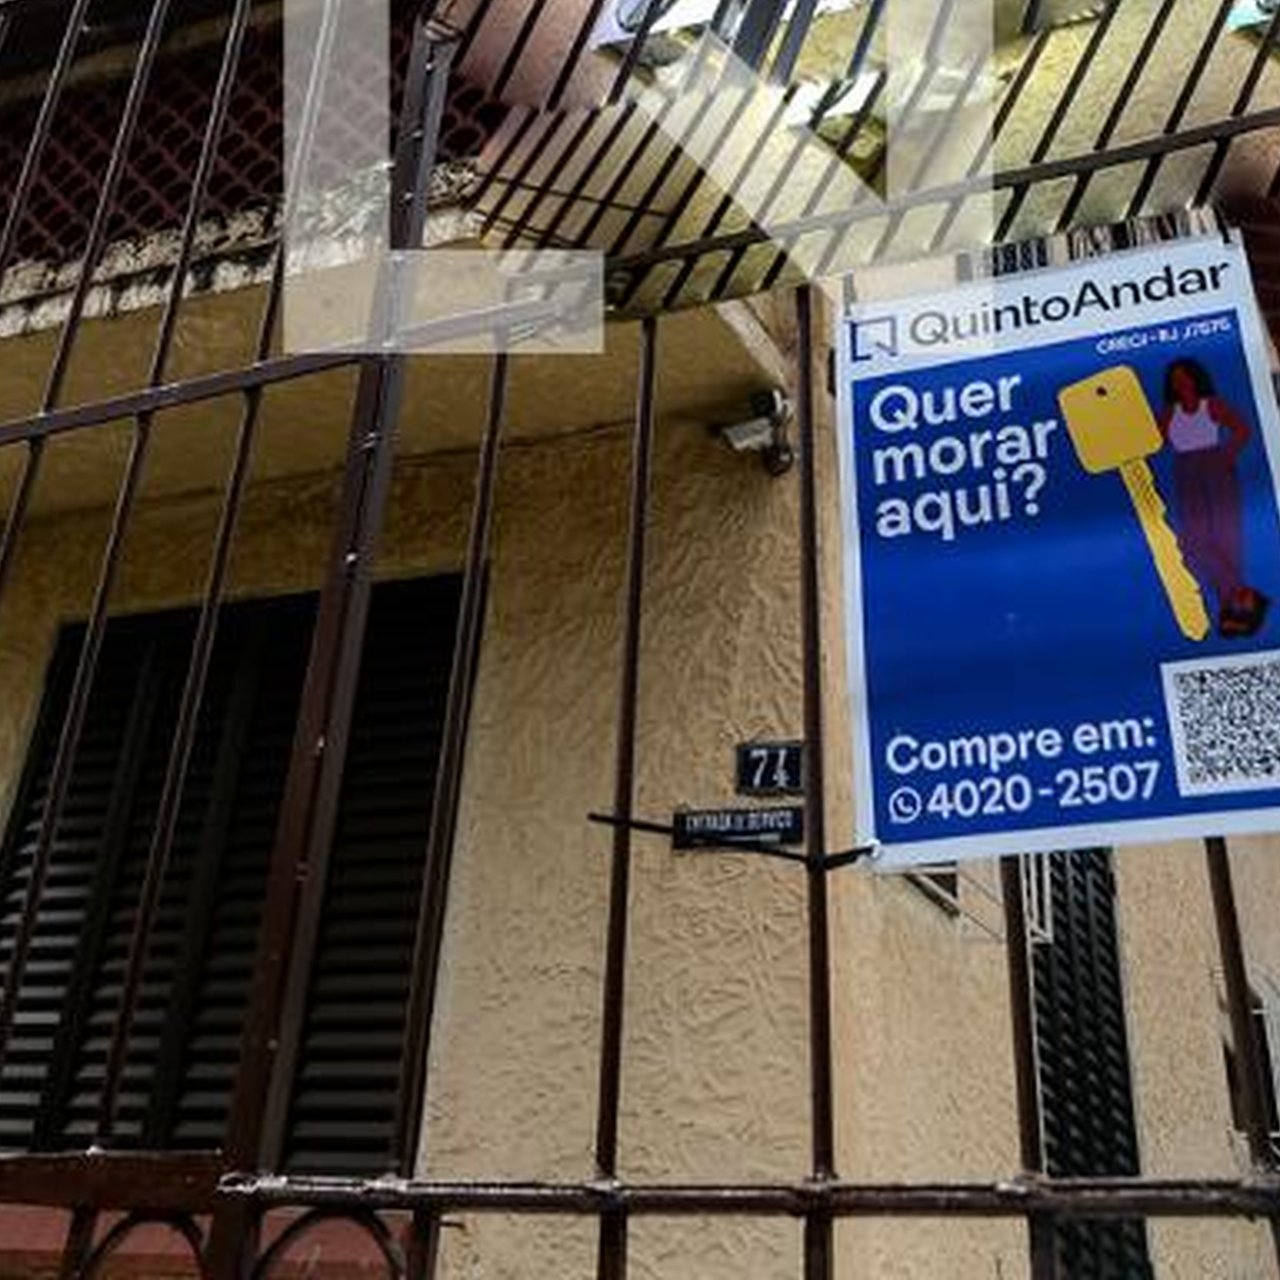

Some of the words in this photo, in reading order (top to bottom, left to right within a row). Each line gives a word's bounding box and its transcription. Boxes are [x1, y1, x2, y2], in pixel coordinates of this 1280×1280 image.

[909, 261, 1231, 347] QuintoAndar
[869, 374, 1022, 433] Quer
[873, 420, 1057, 485] morar
[876, 463, 1046, 540] aqui?
[885, 728, 1063, 774] Compre
[1073, 718, 1155, 754] em:
[926, 760, 1160, 819] 4020-2507
